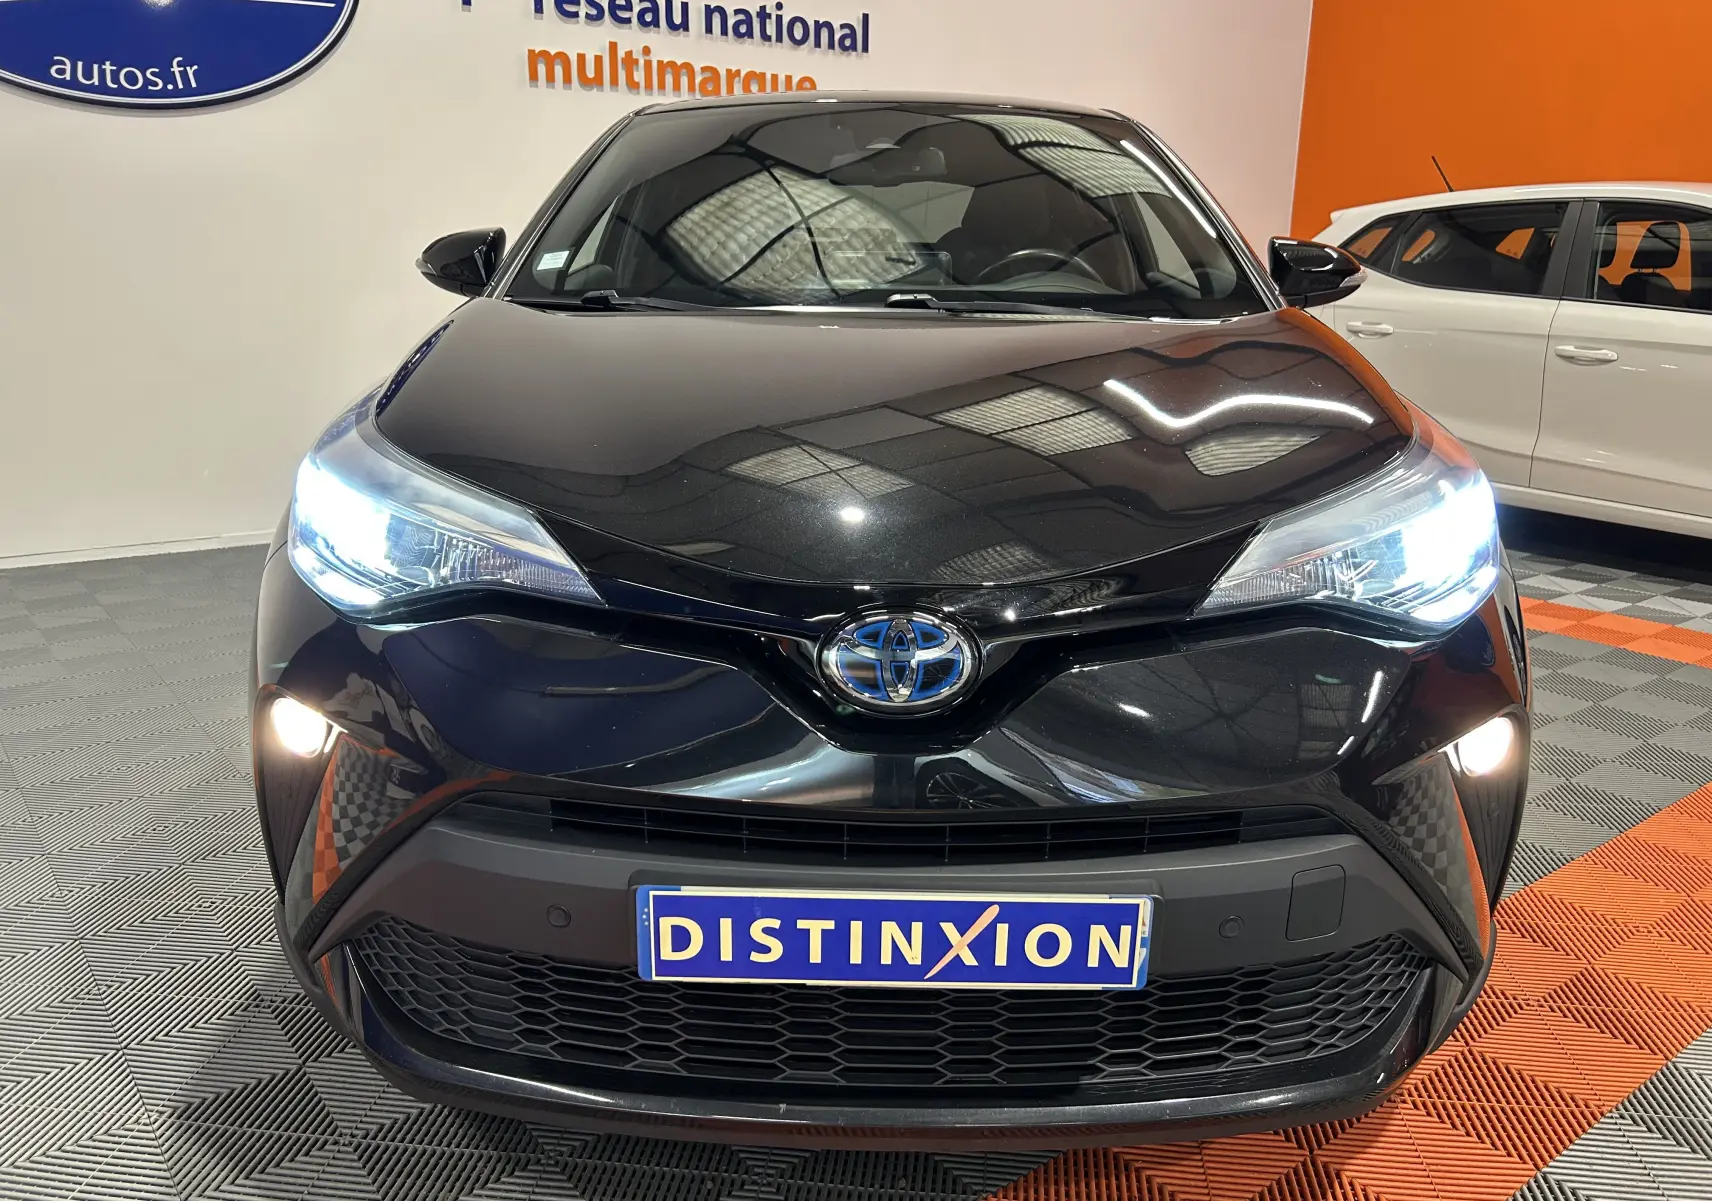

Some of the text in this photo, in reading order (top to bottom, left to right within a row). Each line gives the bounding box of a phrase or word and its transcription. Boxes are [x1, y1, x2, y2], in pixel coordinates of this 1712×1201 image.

[704, 2, 870, 53] national
[50, 56, 198, 90] autos.fr
[658, 905, 1132, 978] DISTINXION
